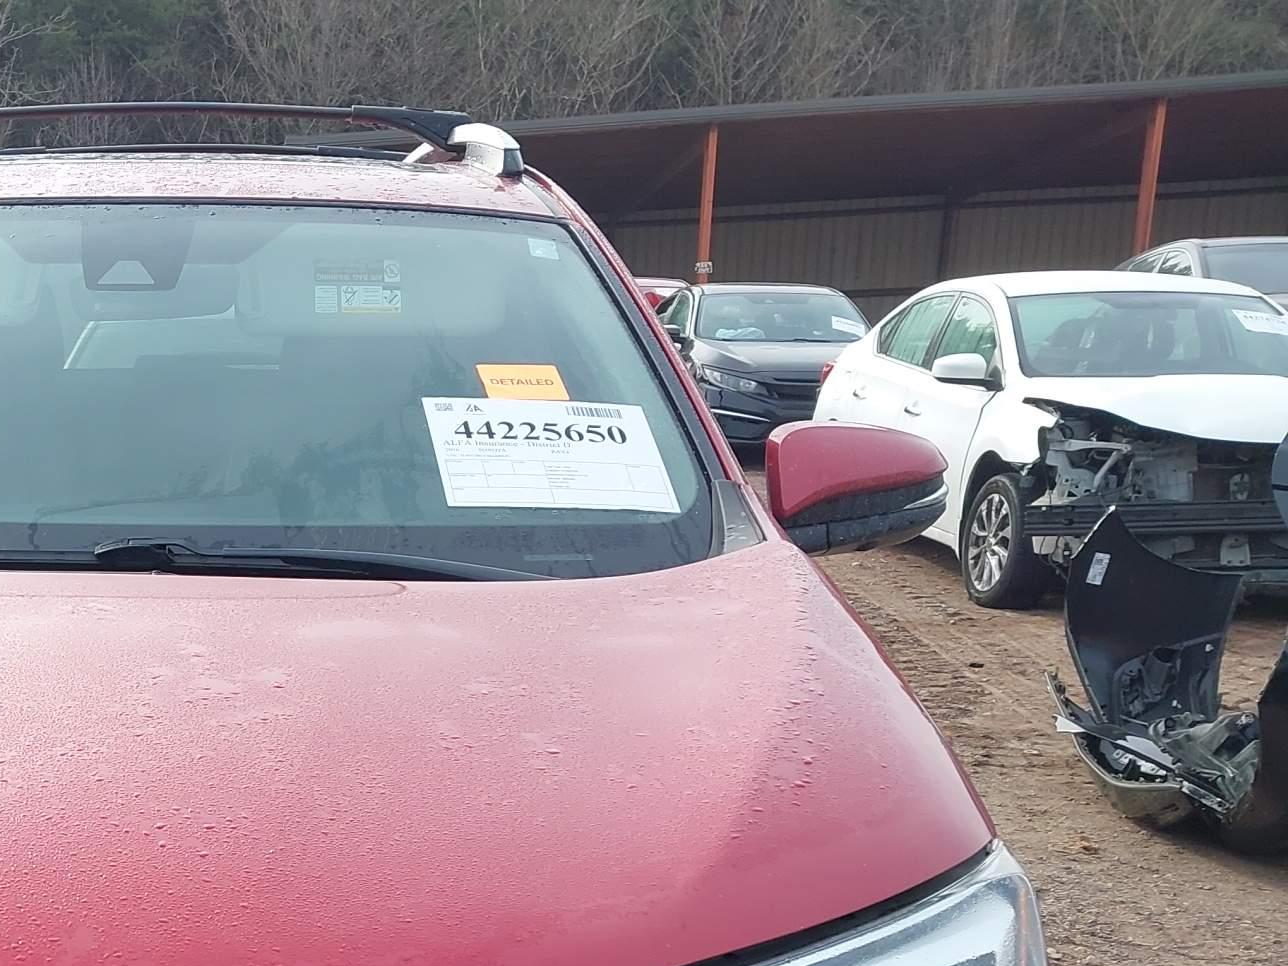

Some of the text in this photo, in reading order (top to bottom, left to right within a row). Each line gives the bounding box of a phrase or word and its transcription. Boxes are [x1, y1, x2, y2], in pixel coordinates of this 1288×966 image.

[489, 378, 554, 386] DETAILED
[454, 420, 627, 445] 44225650
[475, 440, 518, 448] Insurance
